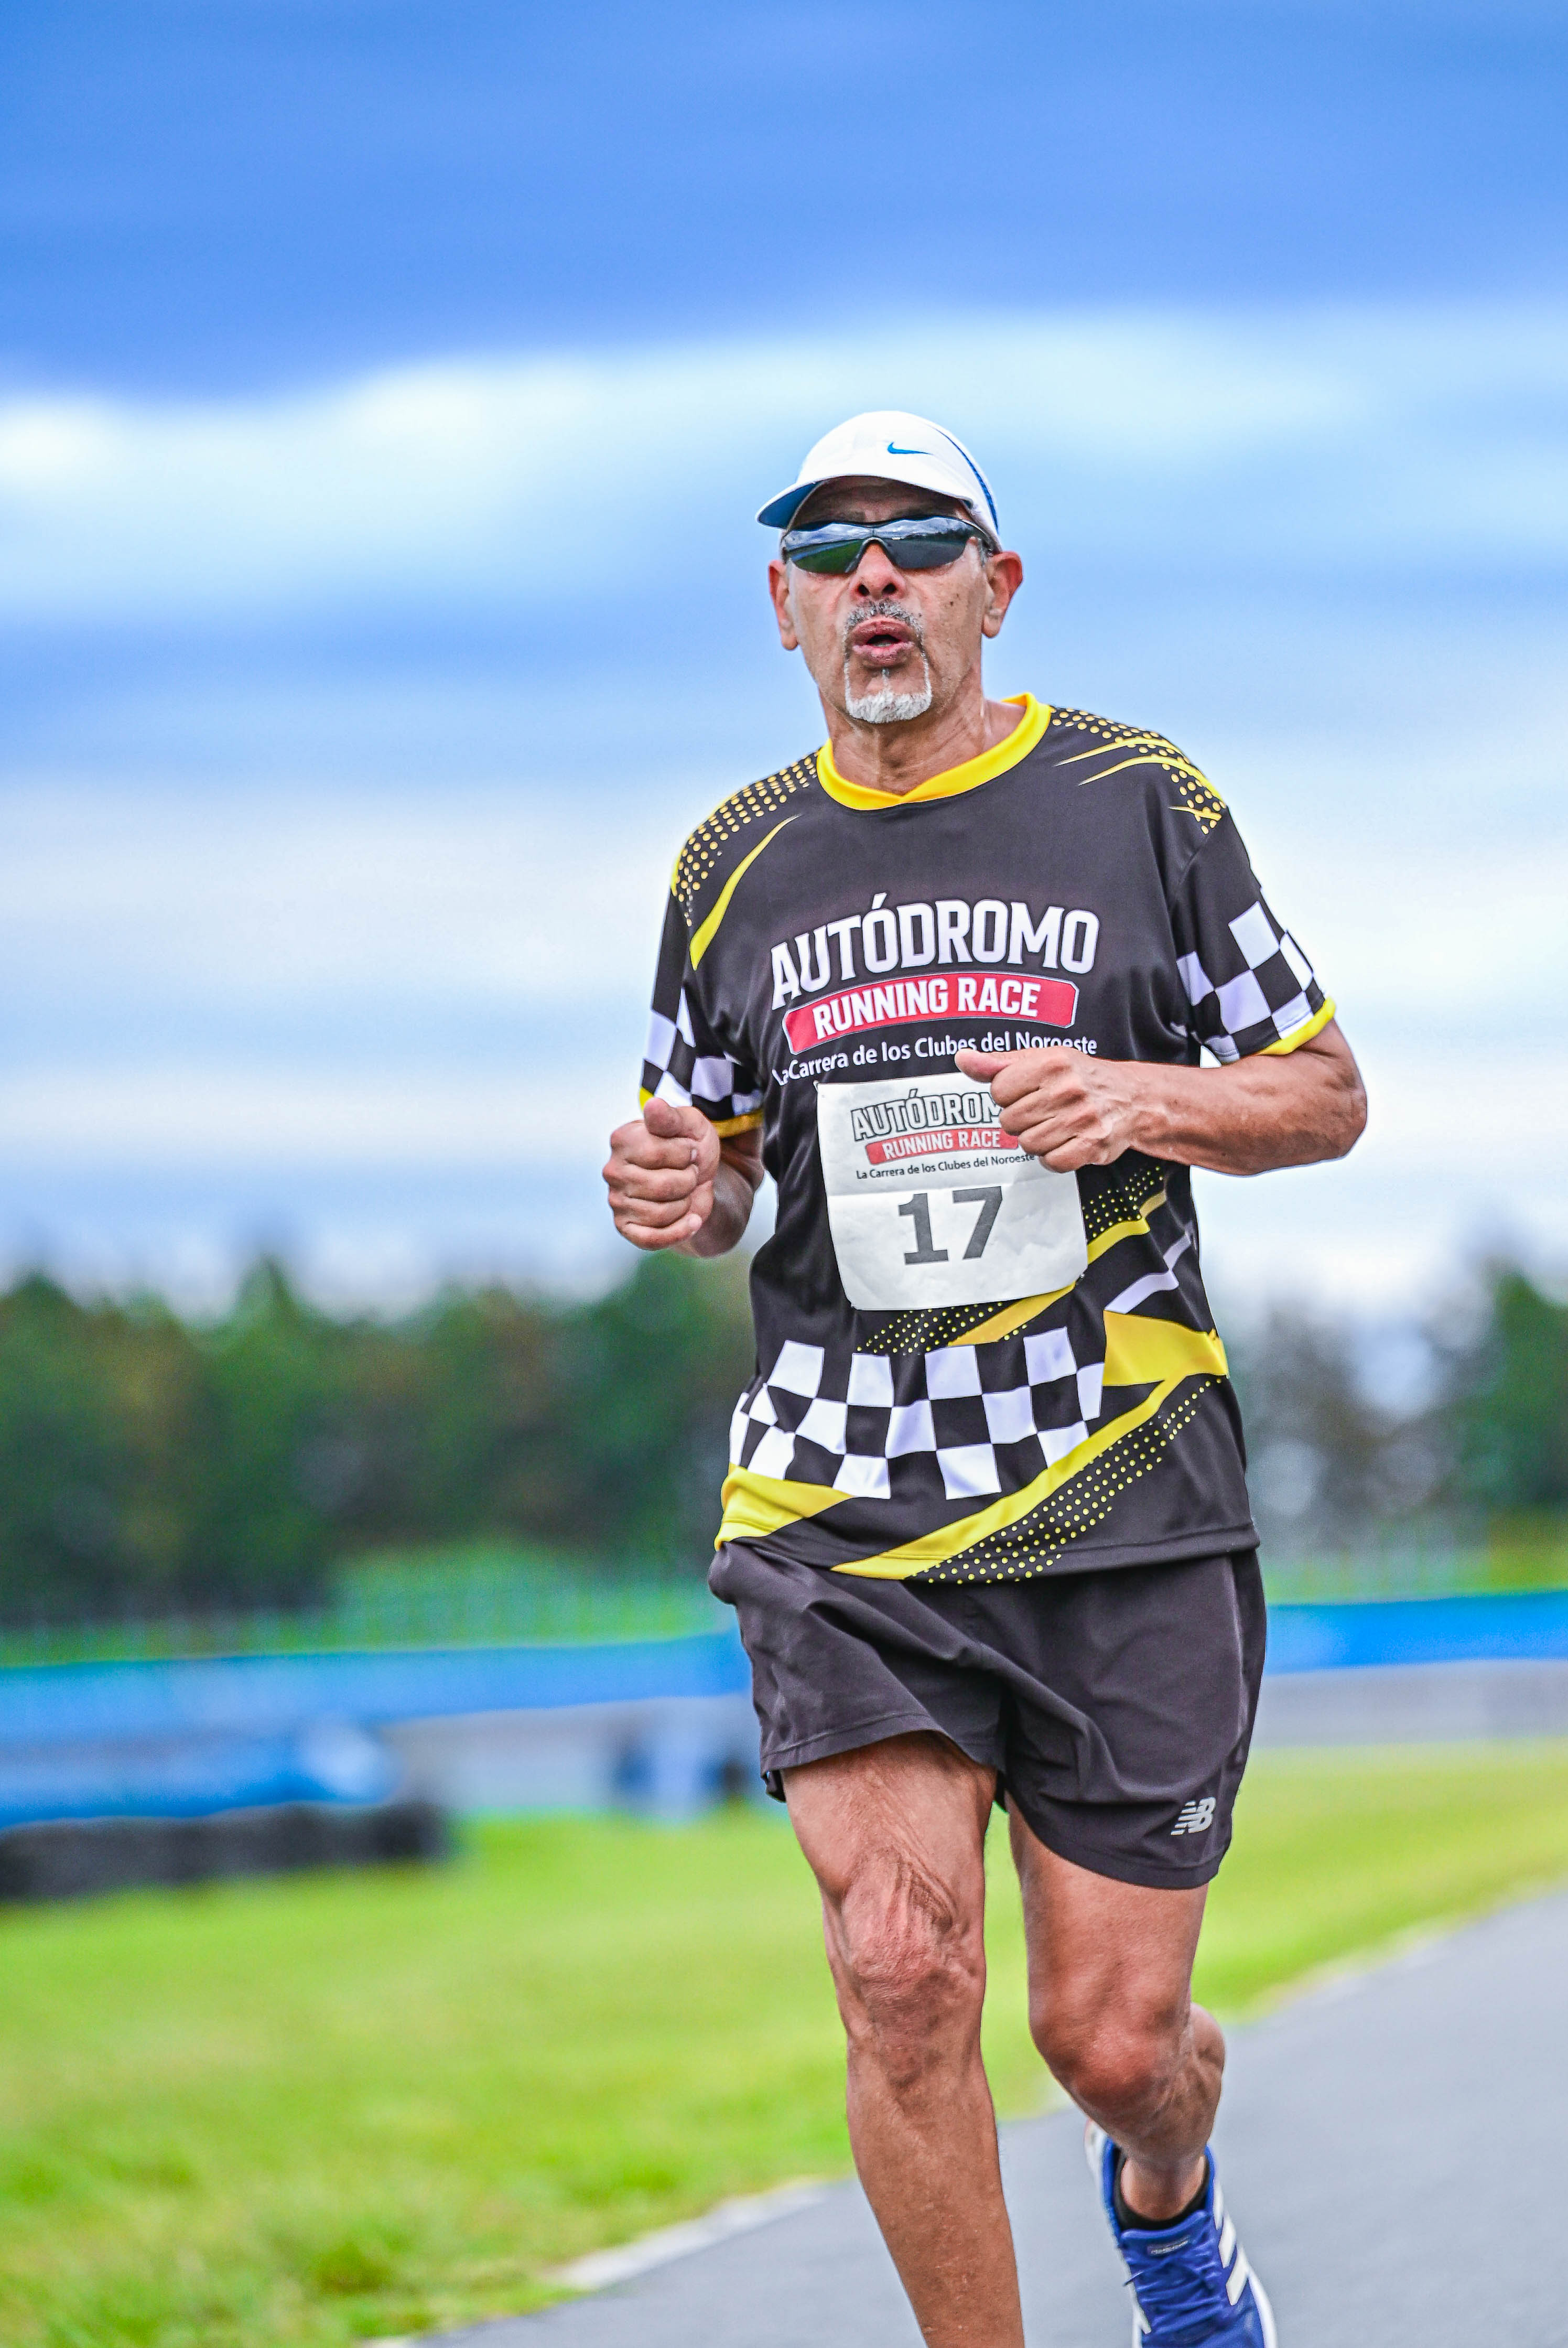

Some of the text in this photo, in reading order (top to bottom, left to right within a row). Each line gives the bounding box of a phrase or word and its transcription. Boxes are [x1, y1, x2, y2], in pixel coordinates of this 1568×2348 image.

[771, 892, 1100, 1010] AUTÓDROMO
[812, 977, 1042, 1039] RUNNING RACE
[772, 1031, 1097, 1086] La Carrera de los Clubes del Noroeste
[851, 1088, 1002, 1142] AUTÓDROM
[856, 1154, 1035, 1180] La Carrera de los Clubes del Noroeste
[882, 1130, 1001, 1160] RUNNING RACE
[898, 1186, 1003, 1266] 17
